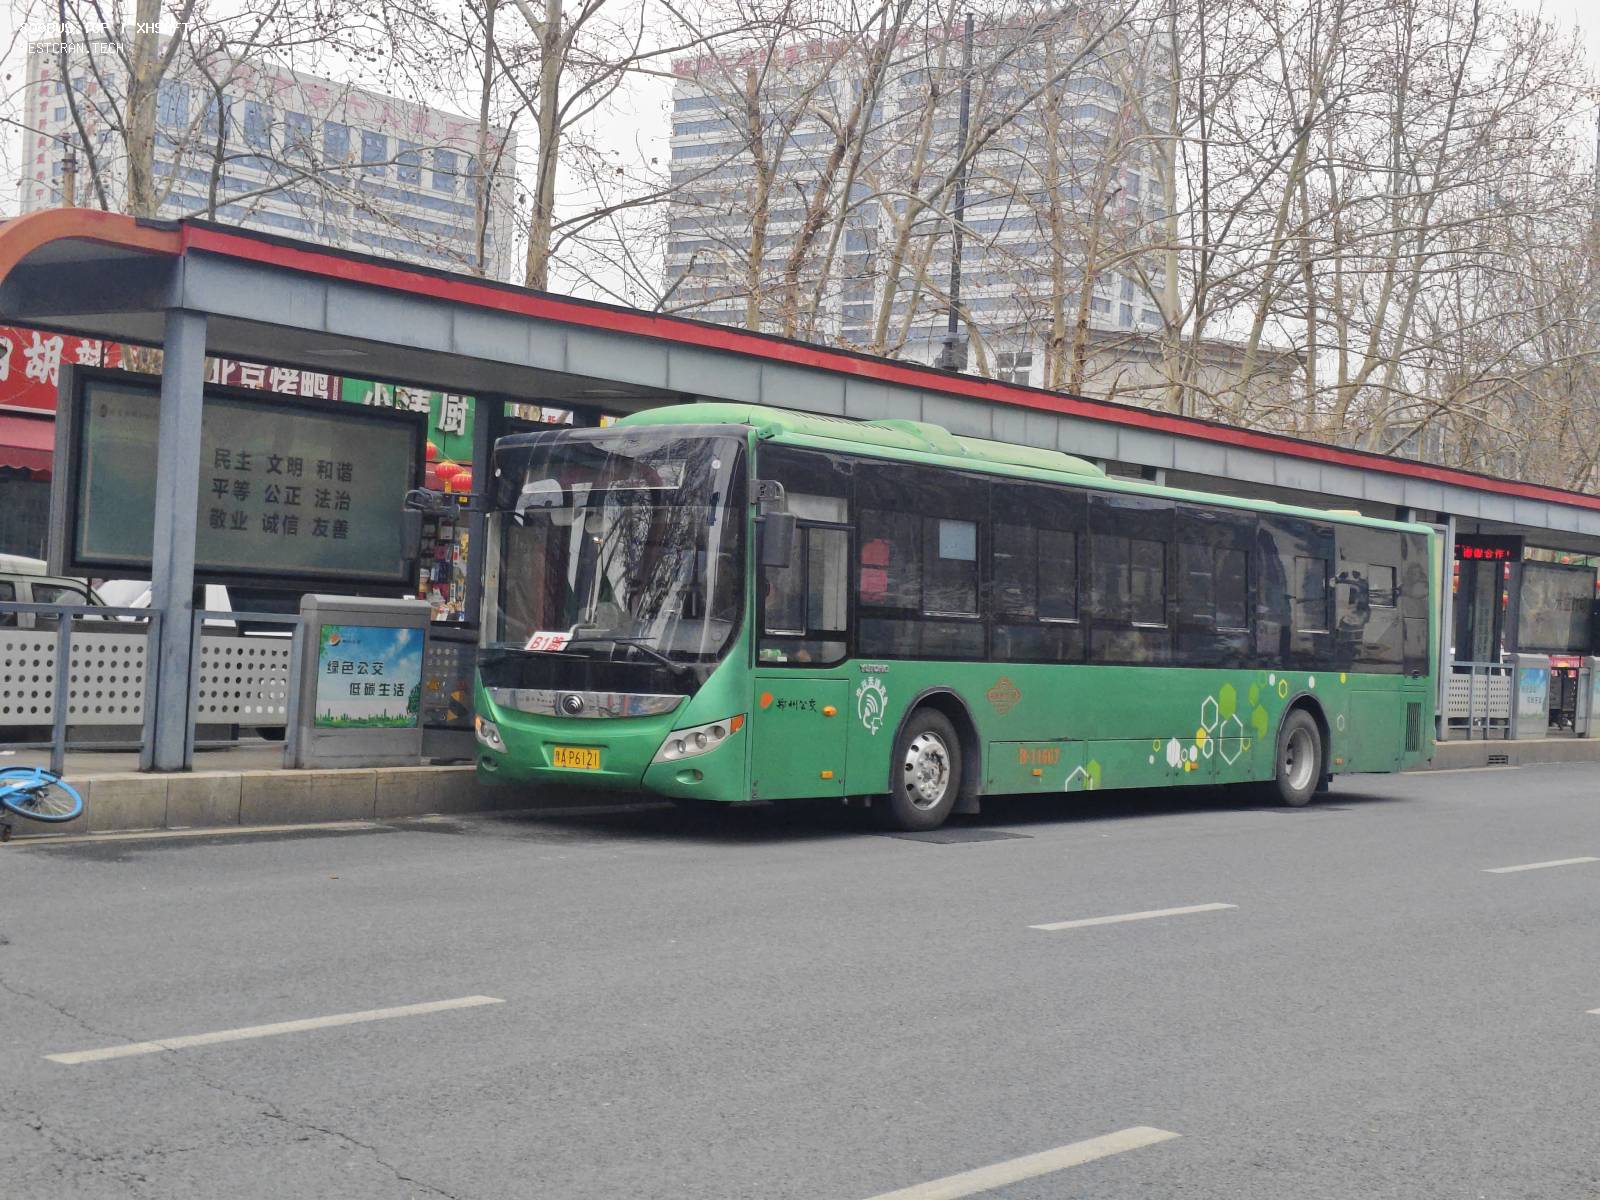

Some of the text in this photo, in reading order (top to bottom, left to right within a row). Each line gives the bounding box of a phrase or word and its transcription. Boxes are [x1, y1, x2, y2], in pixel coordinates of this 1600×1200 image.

[214, 448, 353, 482] 民主 文明 和谐
[211, 478, 351, 511] 平等 公正 法治
[208, 507, 349, 539] 敬业 诚信 友善
[326, 661, 384, 675] 绿色公交
[349, 682, 405, 697] 低碳生活
